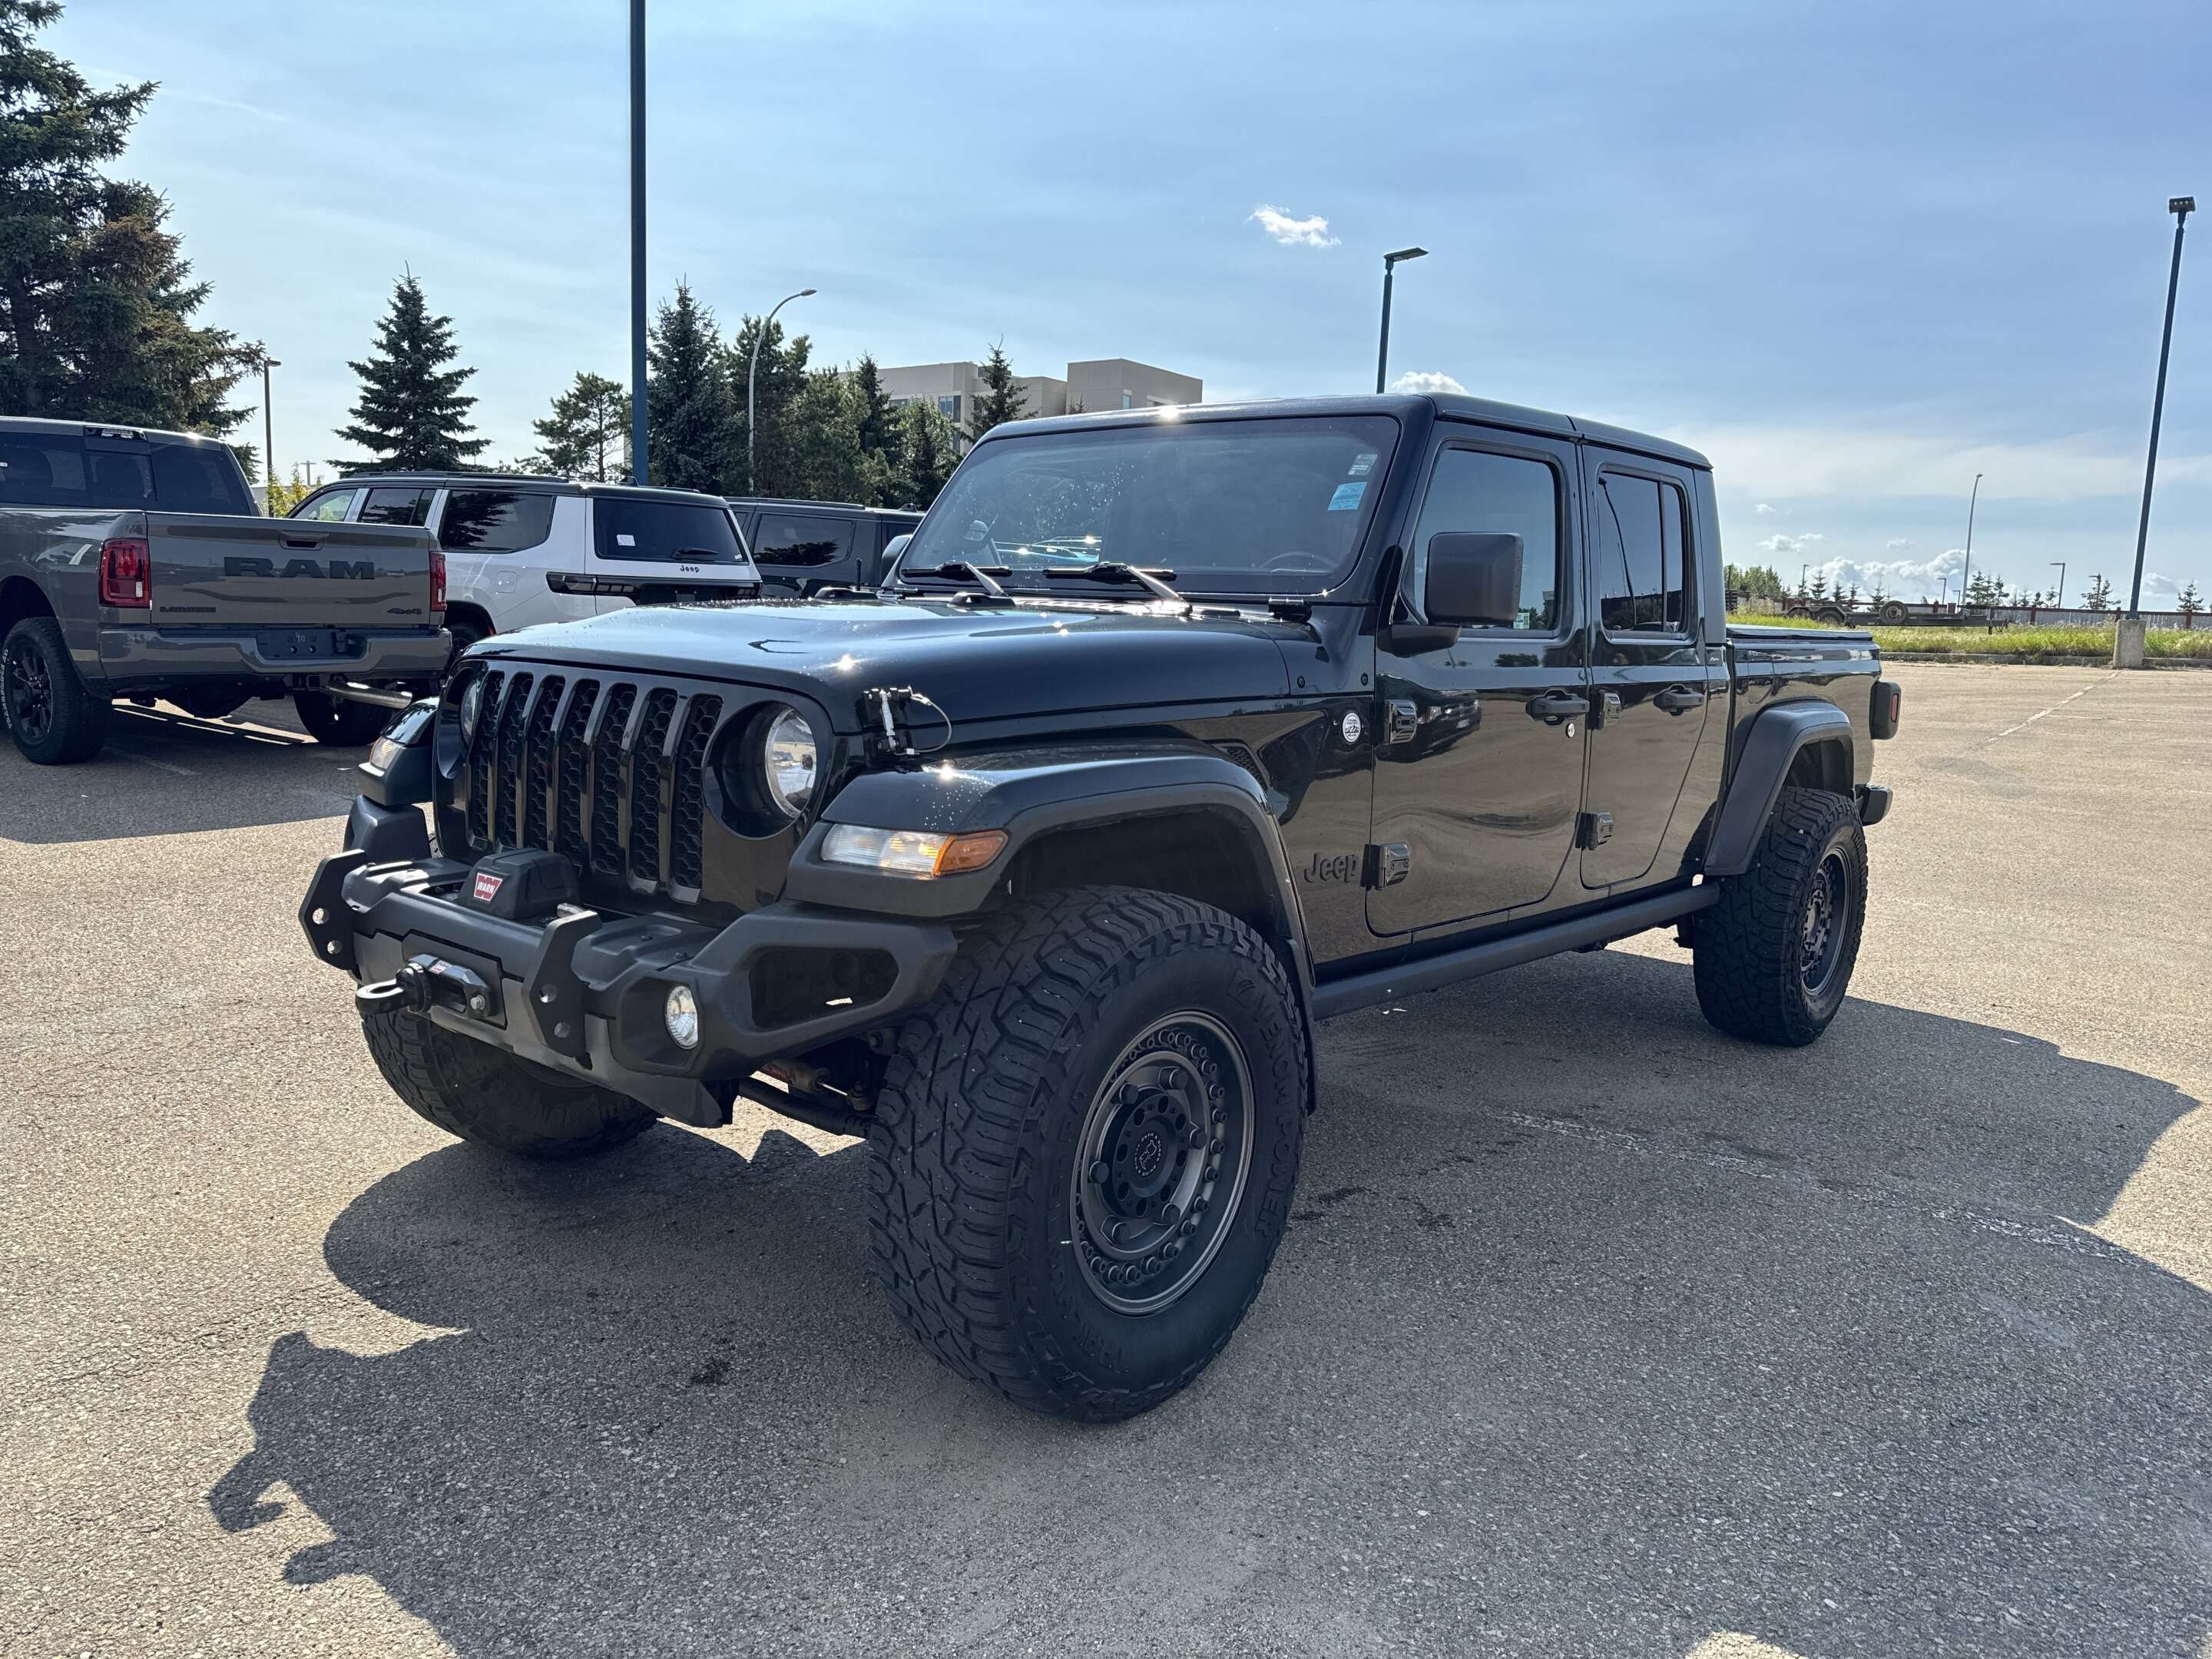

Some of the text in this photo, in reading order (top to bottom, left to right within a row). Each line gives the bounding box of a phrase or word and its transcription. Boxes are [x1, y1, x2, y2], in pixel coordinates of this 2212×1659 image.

[224, 556, 376, 580] RAM
[680, 565, 700, 574] Jeep
[1303, 853, 1359, 884] Jeep
[477, 881, 495, 894] WARN
[1253, 994, 1291, 1239] VENOM POWER
